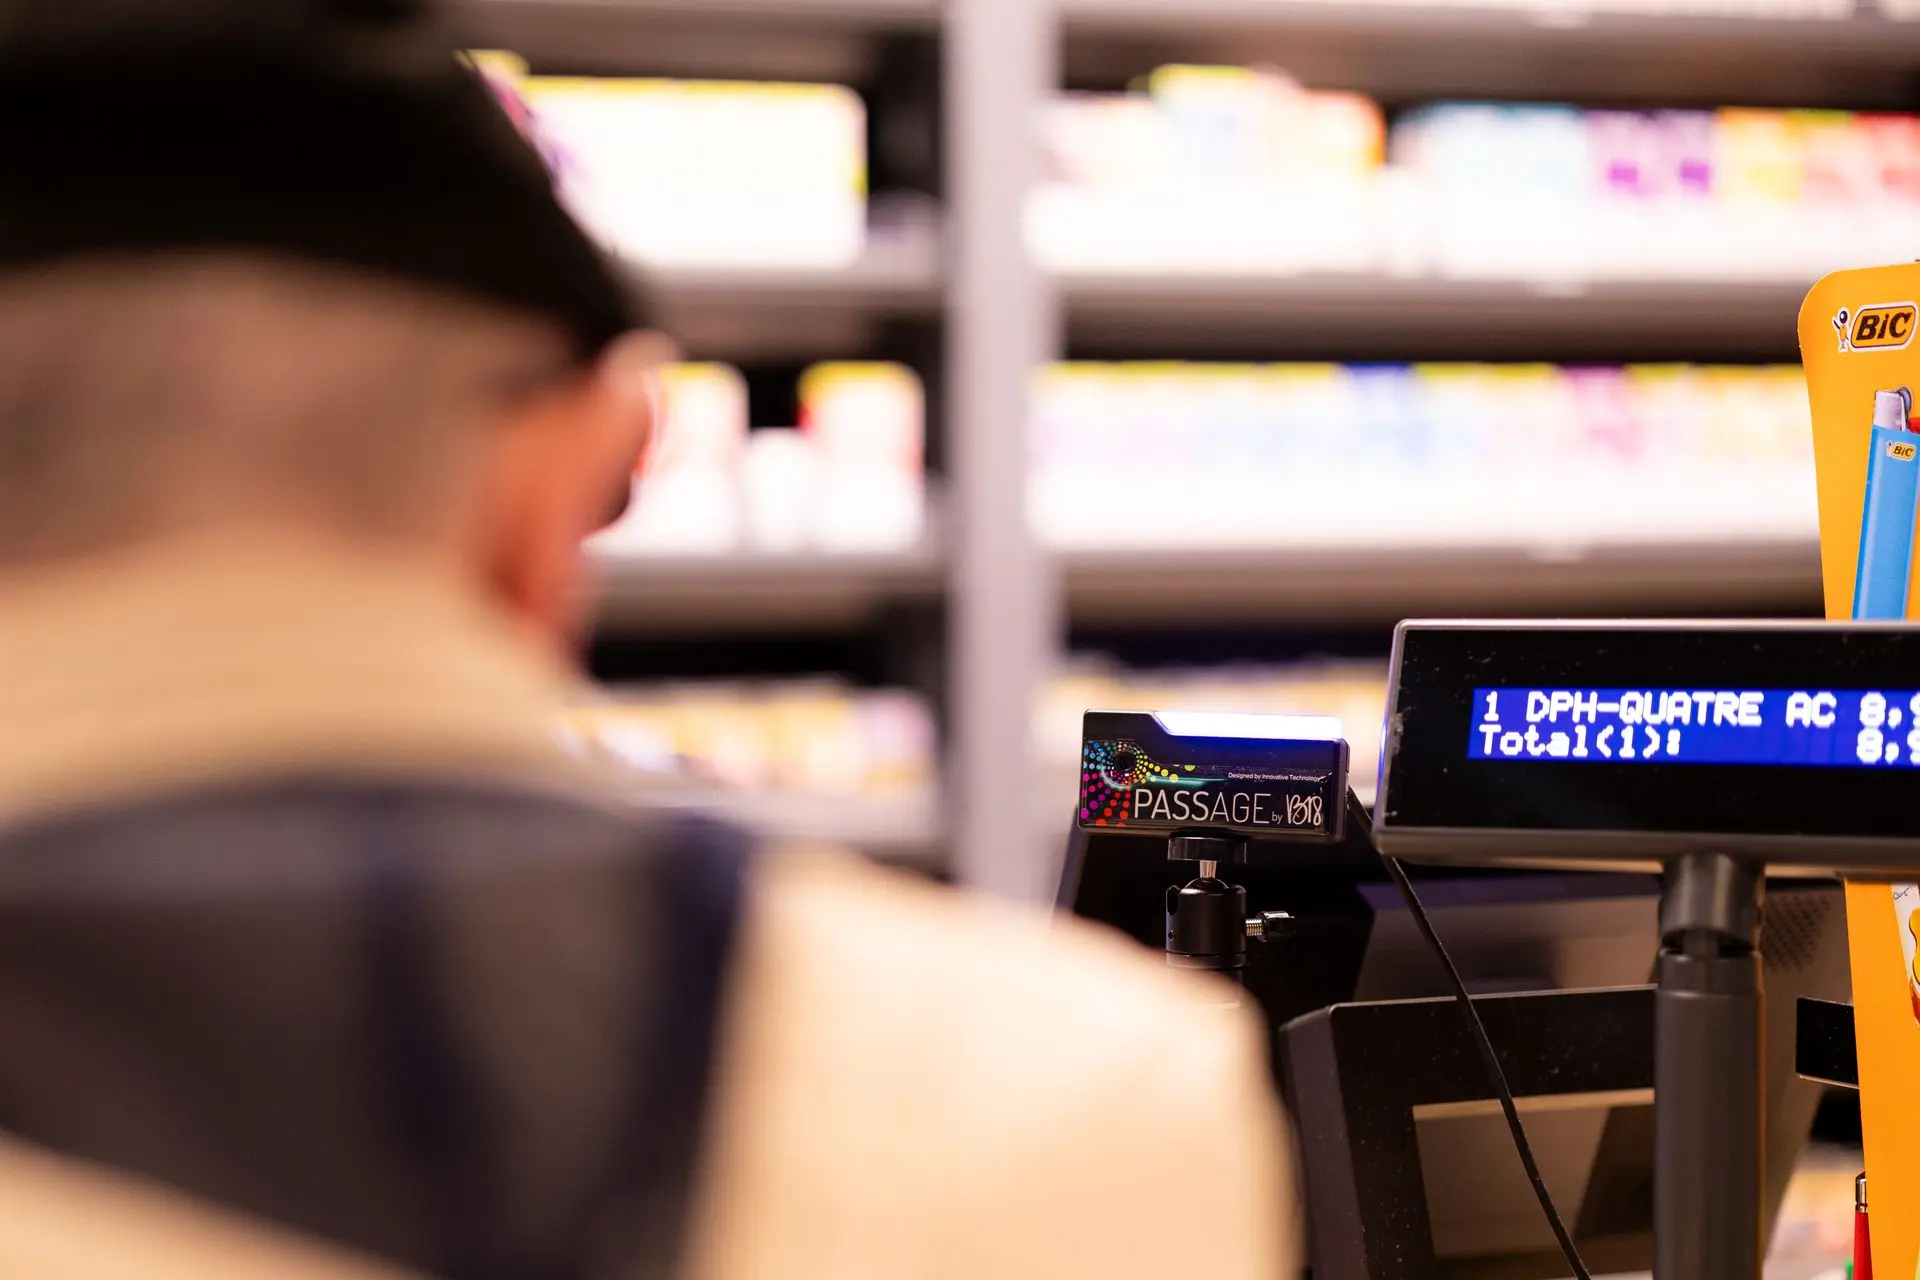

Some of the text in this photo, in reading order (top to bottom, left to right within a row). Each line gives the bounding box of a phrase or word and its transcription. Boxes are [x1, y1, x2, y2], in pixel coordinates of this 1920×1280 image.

[1483, 690, 1500, 721] 1
[1525, 690, 1764, 727] DPH-QUATRE
[1785, 691, 1837, 728] AC
[1478, 724, 1681, 759] Total(1):
[1227, 772, 1320, 783] Designed by Innovative Technology
[1133, 788, 1272, 824] PASSAGE
[1271, 810, 1283, 825] by
